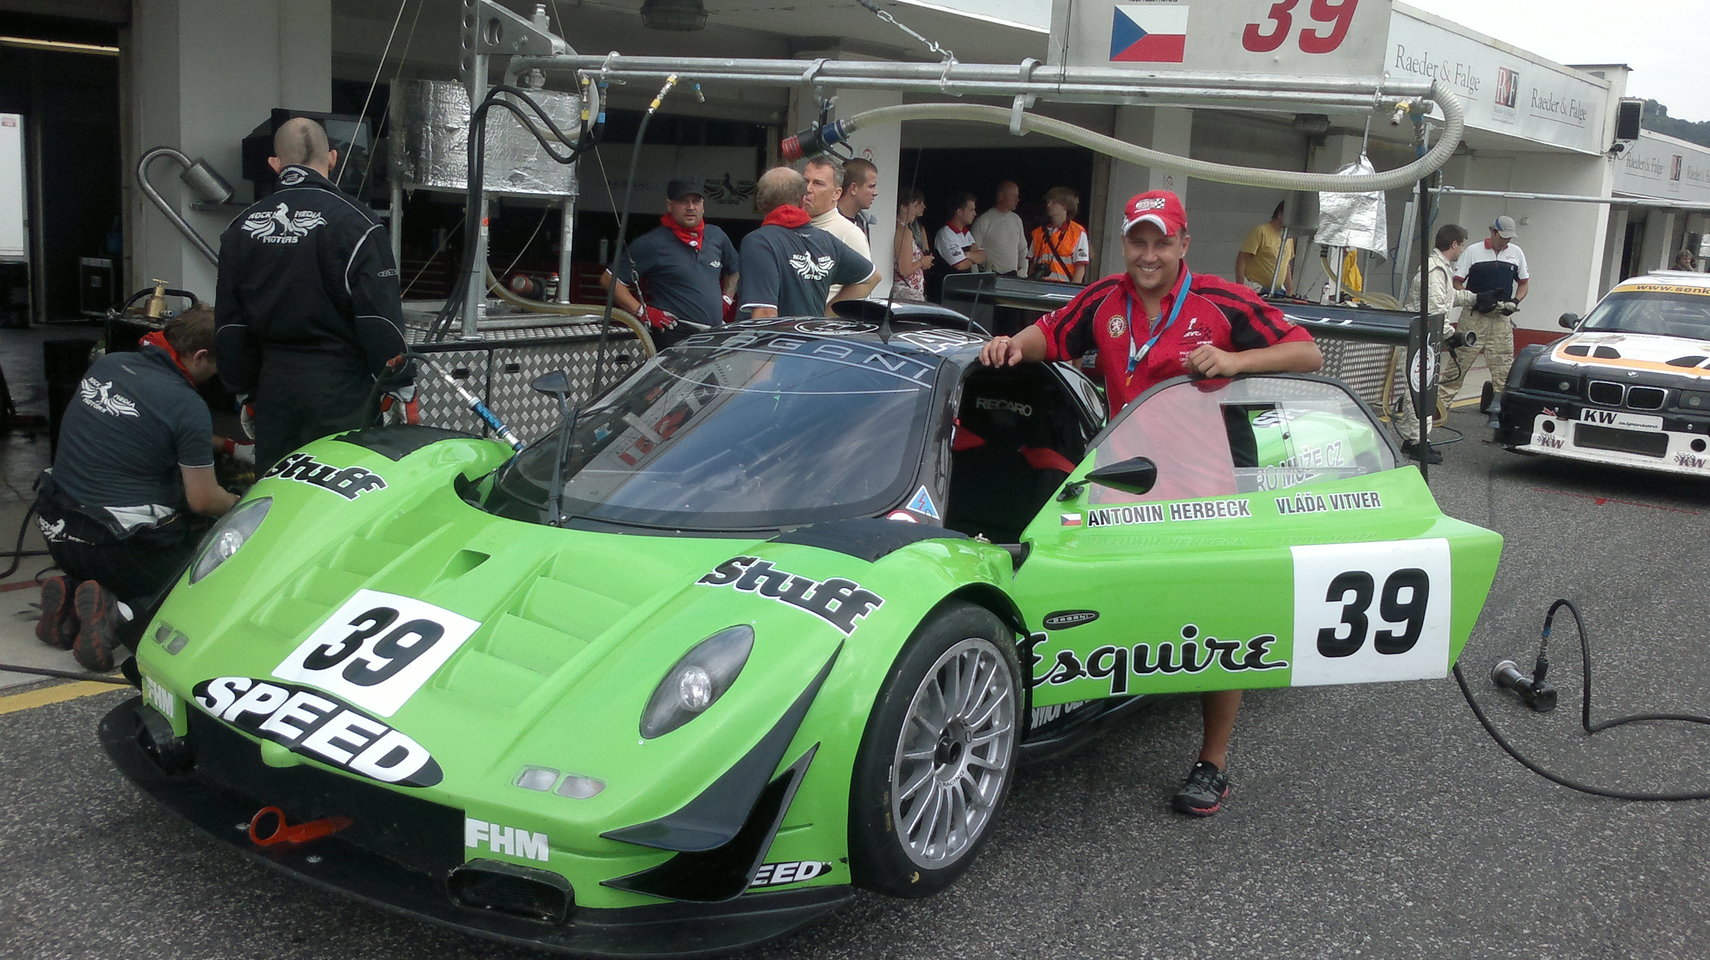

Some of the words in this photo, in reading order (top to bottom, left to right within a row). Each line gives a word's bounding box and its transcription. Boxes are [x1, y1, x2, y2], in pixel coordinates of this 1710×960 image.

[1242, 0, 1359, 53] 39
[1395, 44, 1438, 78] Raeder
[1440, 60, 1451, 83] &
[1454, 63, 1481, 95] Falge
[1531, 88, 1559, 113] Raeder
[1560, 99, 1568, 115] &
[1569, 98, 1588, 123] Falge
[293, 210, 322, 219] MEDIA
[674, 335, 930, 380] PAGANI
[113, 393, 136, 409] MEDIA
[976, 397, 1032, 417] RECARO
[1584, 409, 1617, 424] KW
[1541, 436, 1564, 449] KW
[1679, 454, 1706, 468] KW
[263, 453, 388, 501] Stuff
[1087, 505, 1164, 527] ANTONIN
[1170, 499, 1251, 521] HERBECK
[1275, 493, 1326, 515] VLÁĎA
[1330, 491, 1382, 511] VITVER
[695, 556, 886, 637] Stuff
[1316, 568, 1430, 658] 39
[302, 606, 445, 687] 39
[1022, 625, 1289, 694] Esquire
[145, 675, 174, 718] FHM
[195, 676, 431, 783] SPEED
[465, 817, 549, 862] FHM
